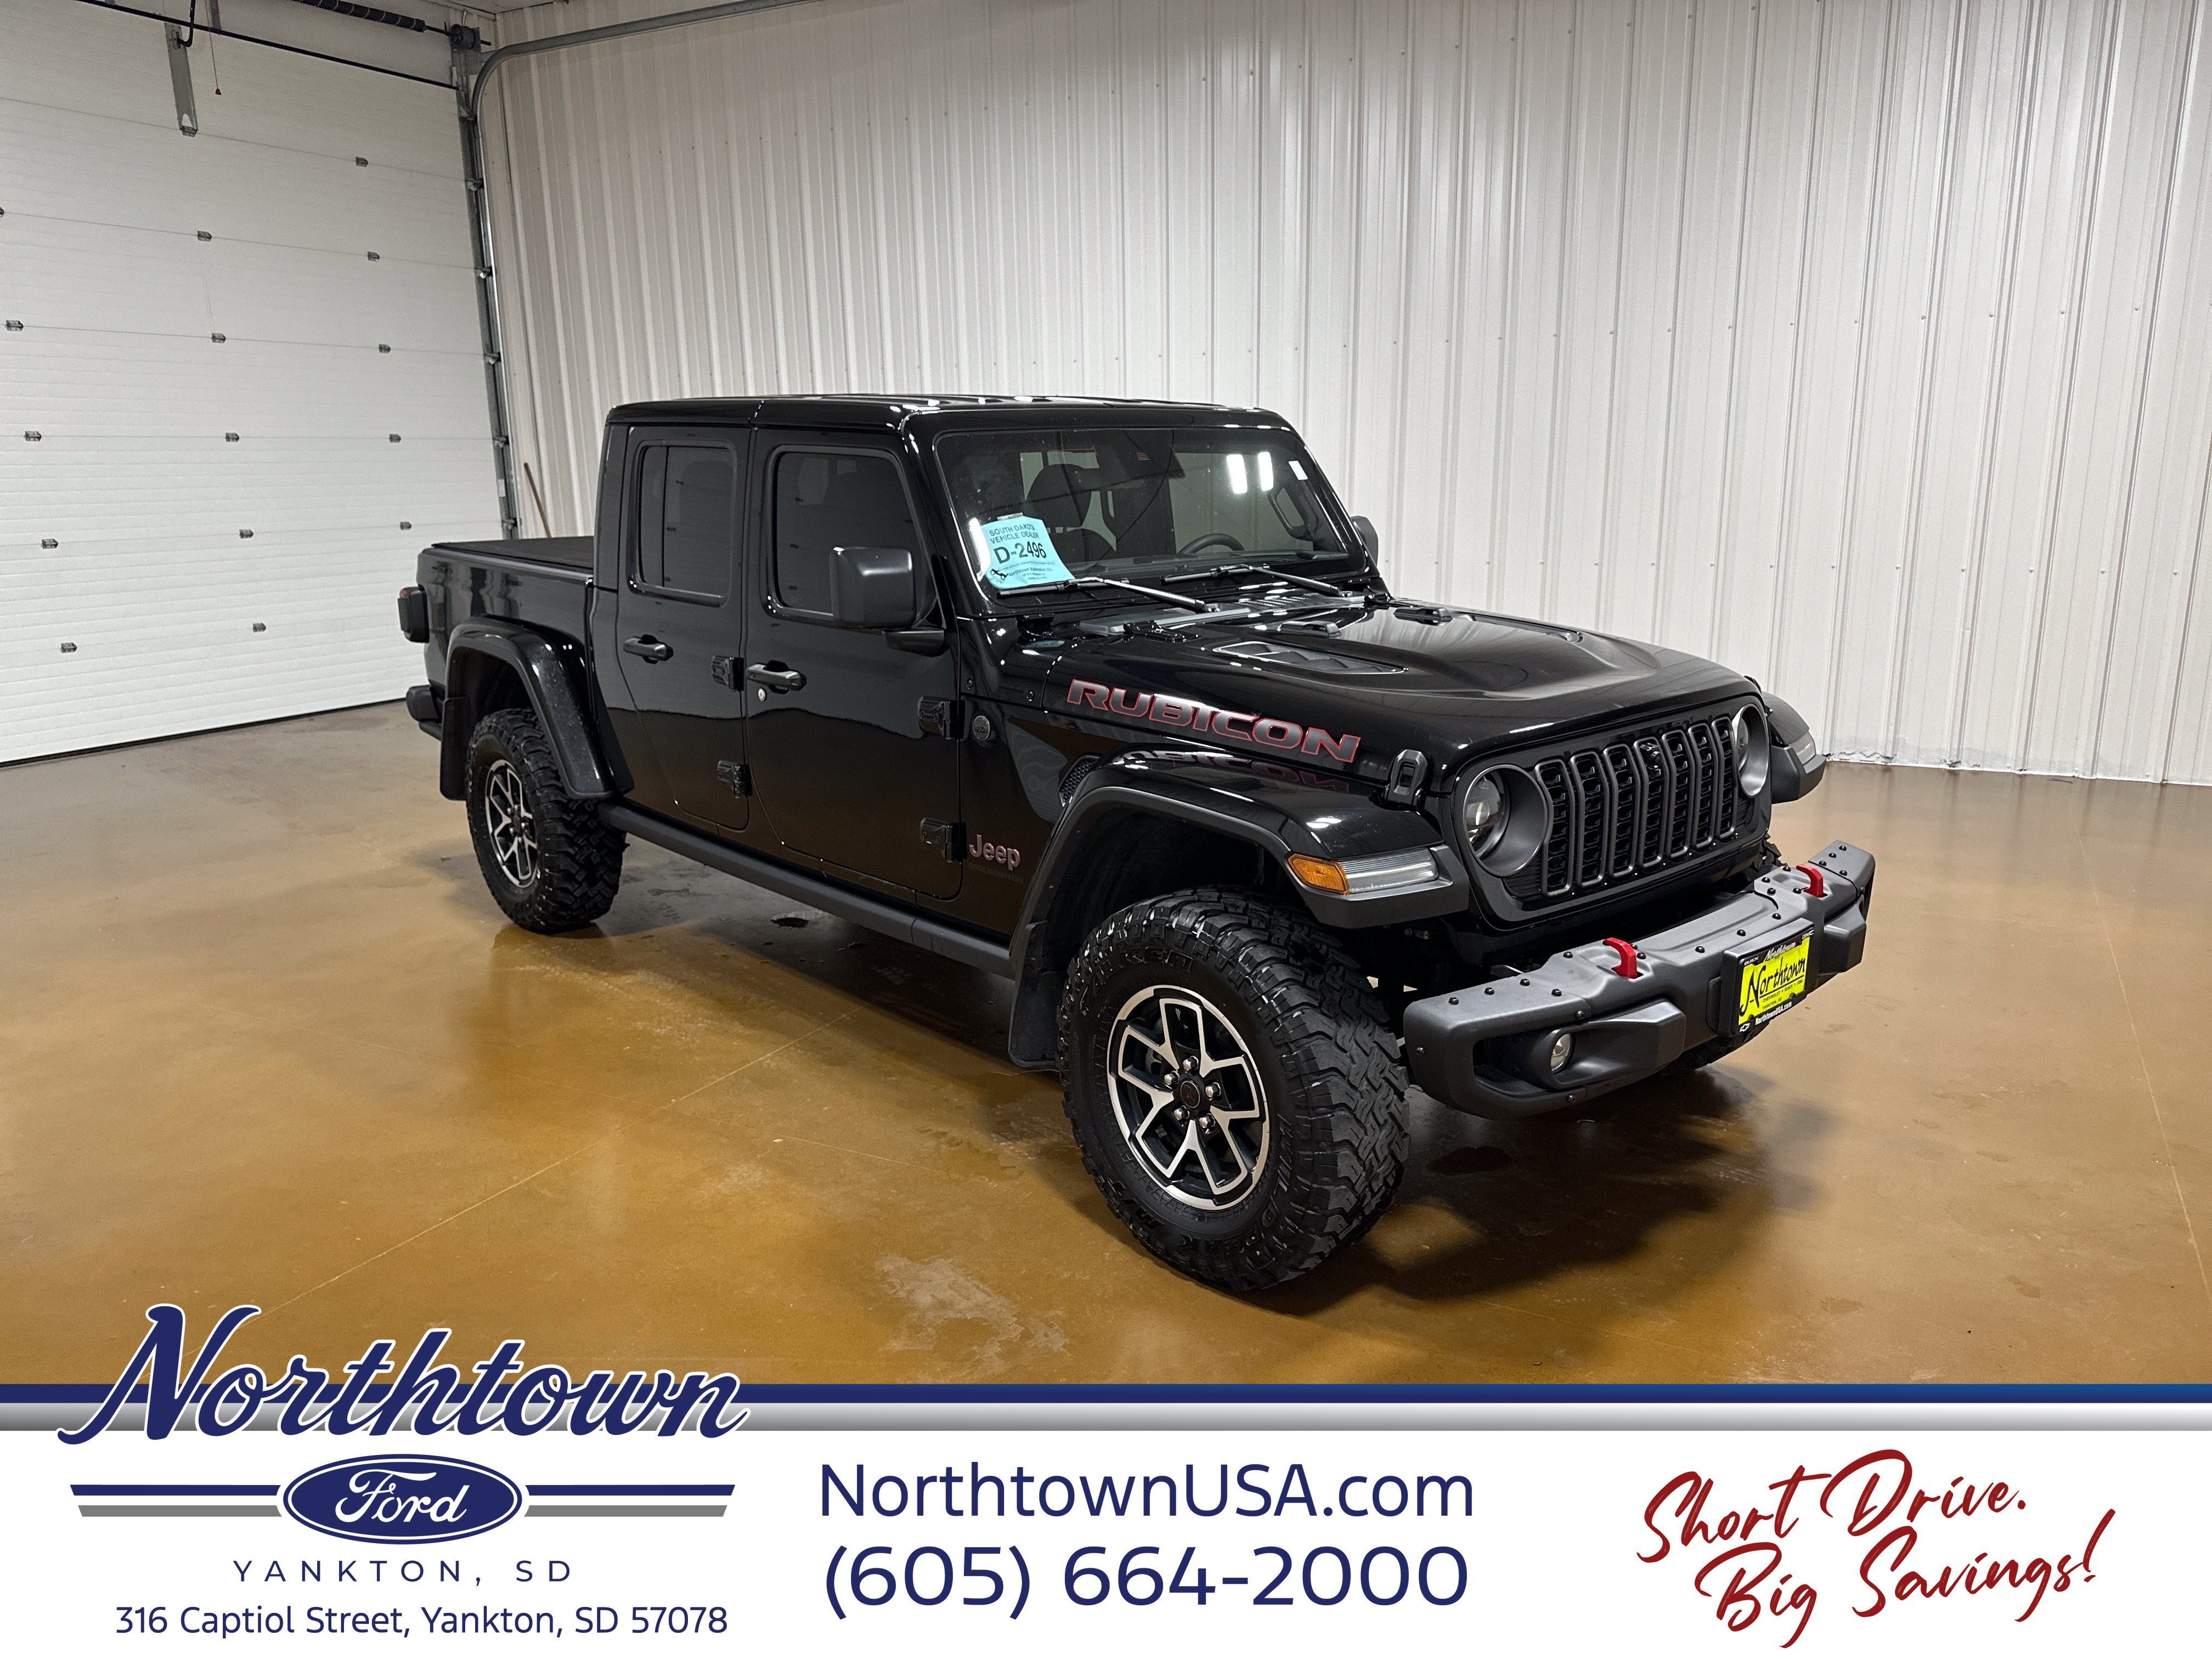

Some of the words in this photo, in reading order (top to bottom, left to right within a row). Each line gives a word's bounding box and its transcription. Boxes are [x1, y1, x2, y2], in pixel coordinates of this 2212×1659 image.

[989, 527, 1013, 536] SOUTH
[990, 533, 1020, 544] VEHICLE
[1020, 531, 1039, 539] DEALER
[994, 540, 1046, 564] D-2496
[1066, 679, 1362, 763] RUBICON
[969, 834, 1022, 872] Jeep
[1802, 929, 1814, 939] GMC
[1744, 956, 1759, 966] BUICK
[1763, 942, 1796, 962] Northtown
[1739, 957, 1805, 1017] Northtown
[1756, 1002, 1792, 1025] NorthtownUSA.com
